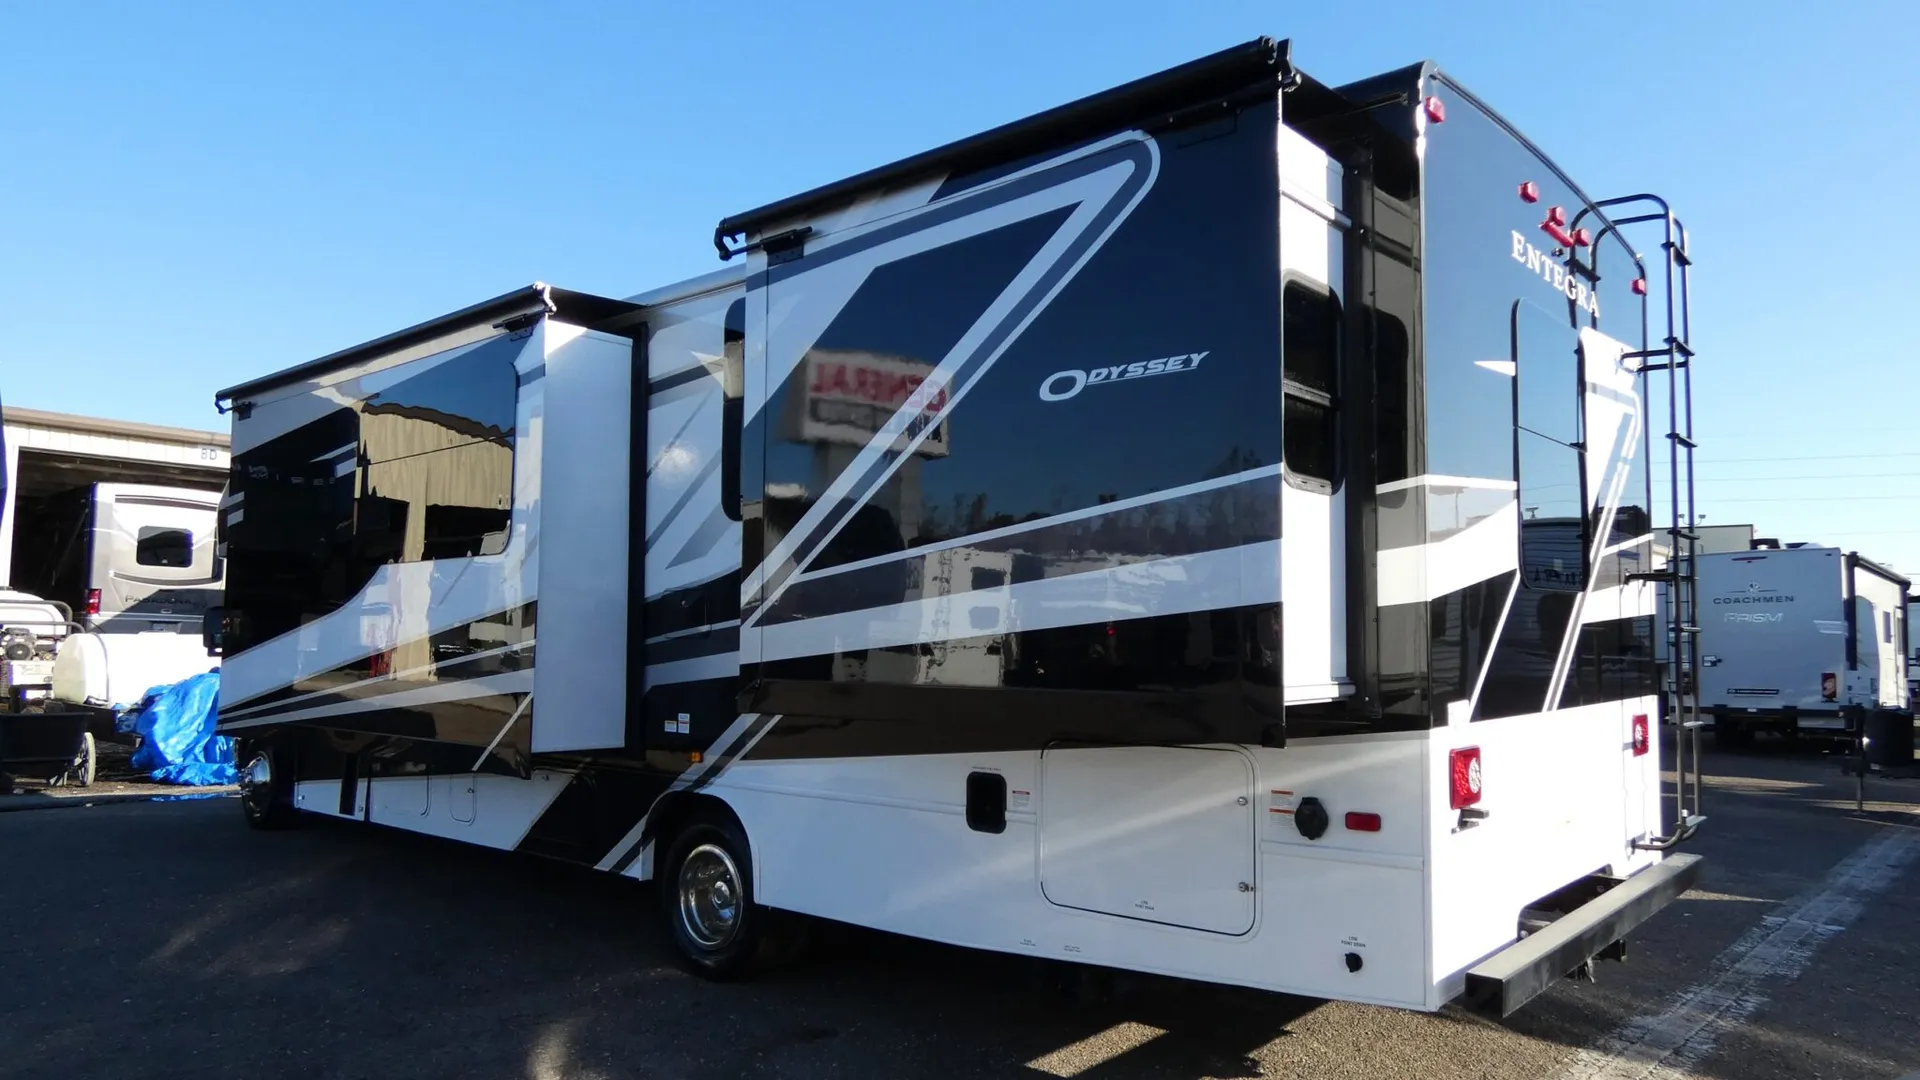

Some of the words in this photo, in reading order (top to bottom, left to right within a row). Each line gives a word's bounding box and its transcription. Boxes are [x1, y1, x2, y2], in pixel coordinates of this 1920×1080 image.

[1511, 230, 1600, 318] ENTEGRA
[1039, 351, 1210, 402] ODYSSEY
[201, 447, 217, 460] 8D
[1713, 595, 1795, 605] COACHMEN
[1724, 612, 1784, 623] PRISM
